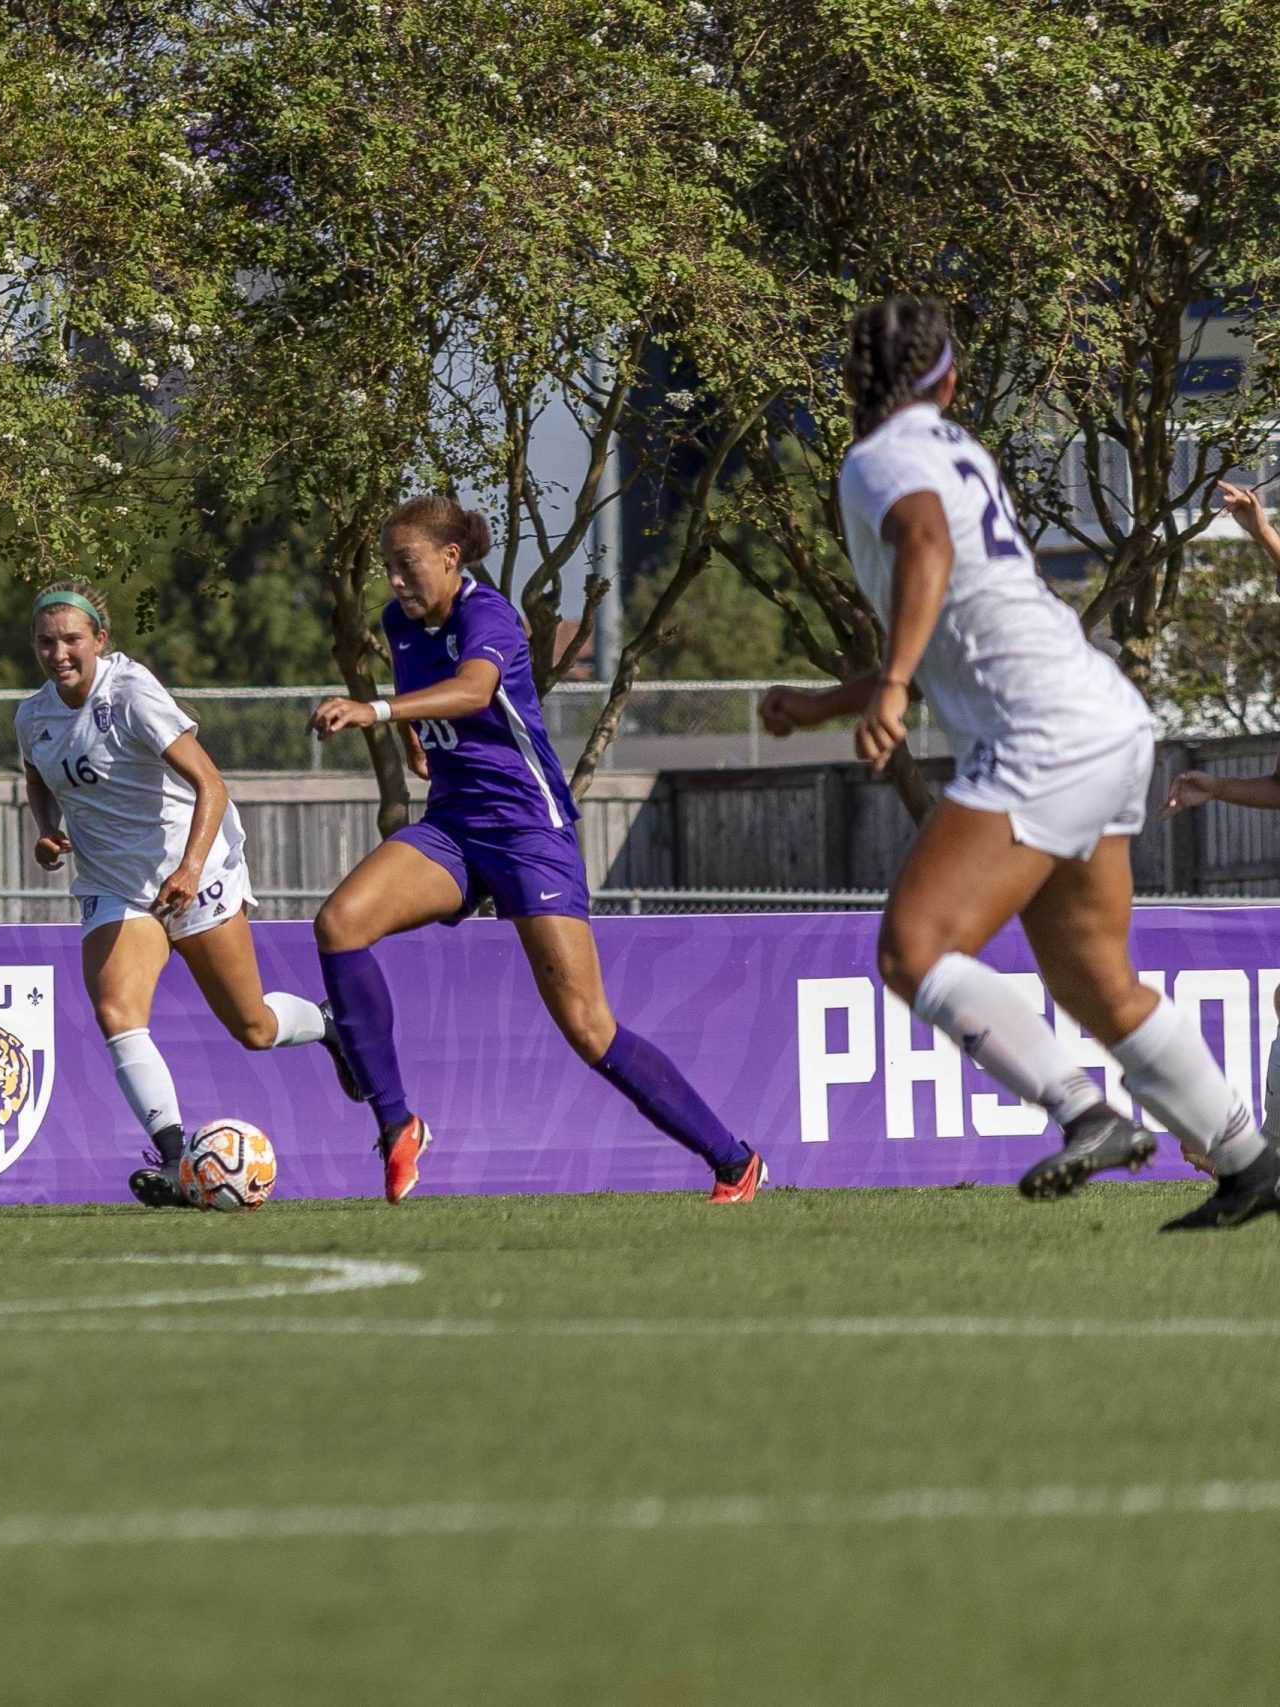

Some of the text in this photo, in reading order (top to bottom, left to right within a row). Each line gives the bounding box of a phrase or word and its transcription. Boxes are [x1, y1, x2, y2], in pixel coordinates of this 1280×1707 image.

[419, 718, 459, 751] 20
[61, 754, 99, 788] 16
[797, 969, 1280, 1143] PASO
